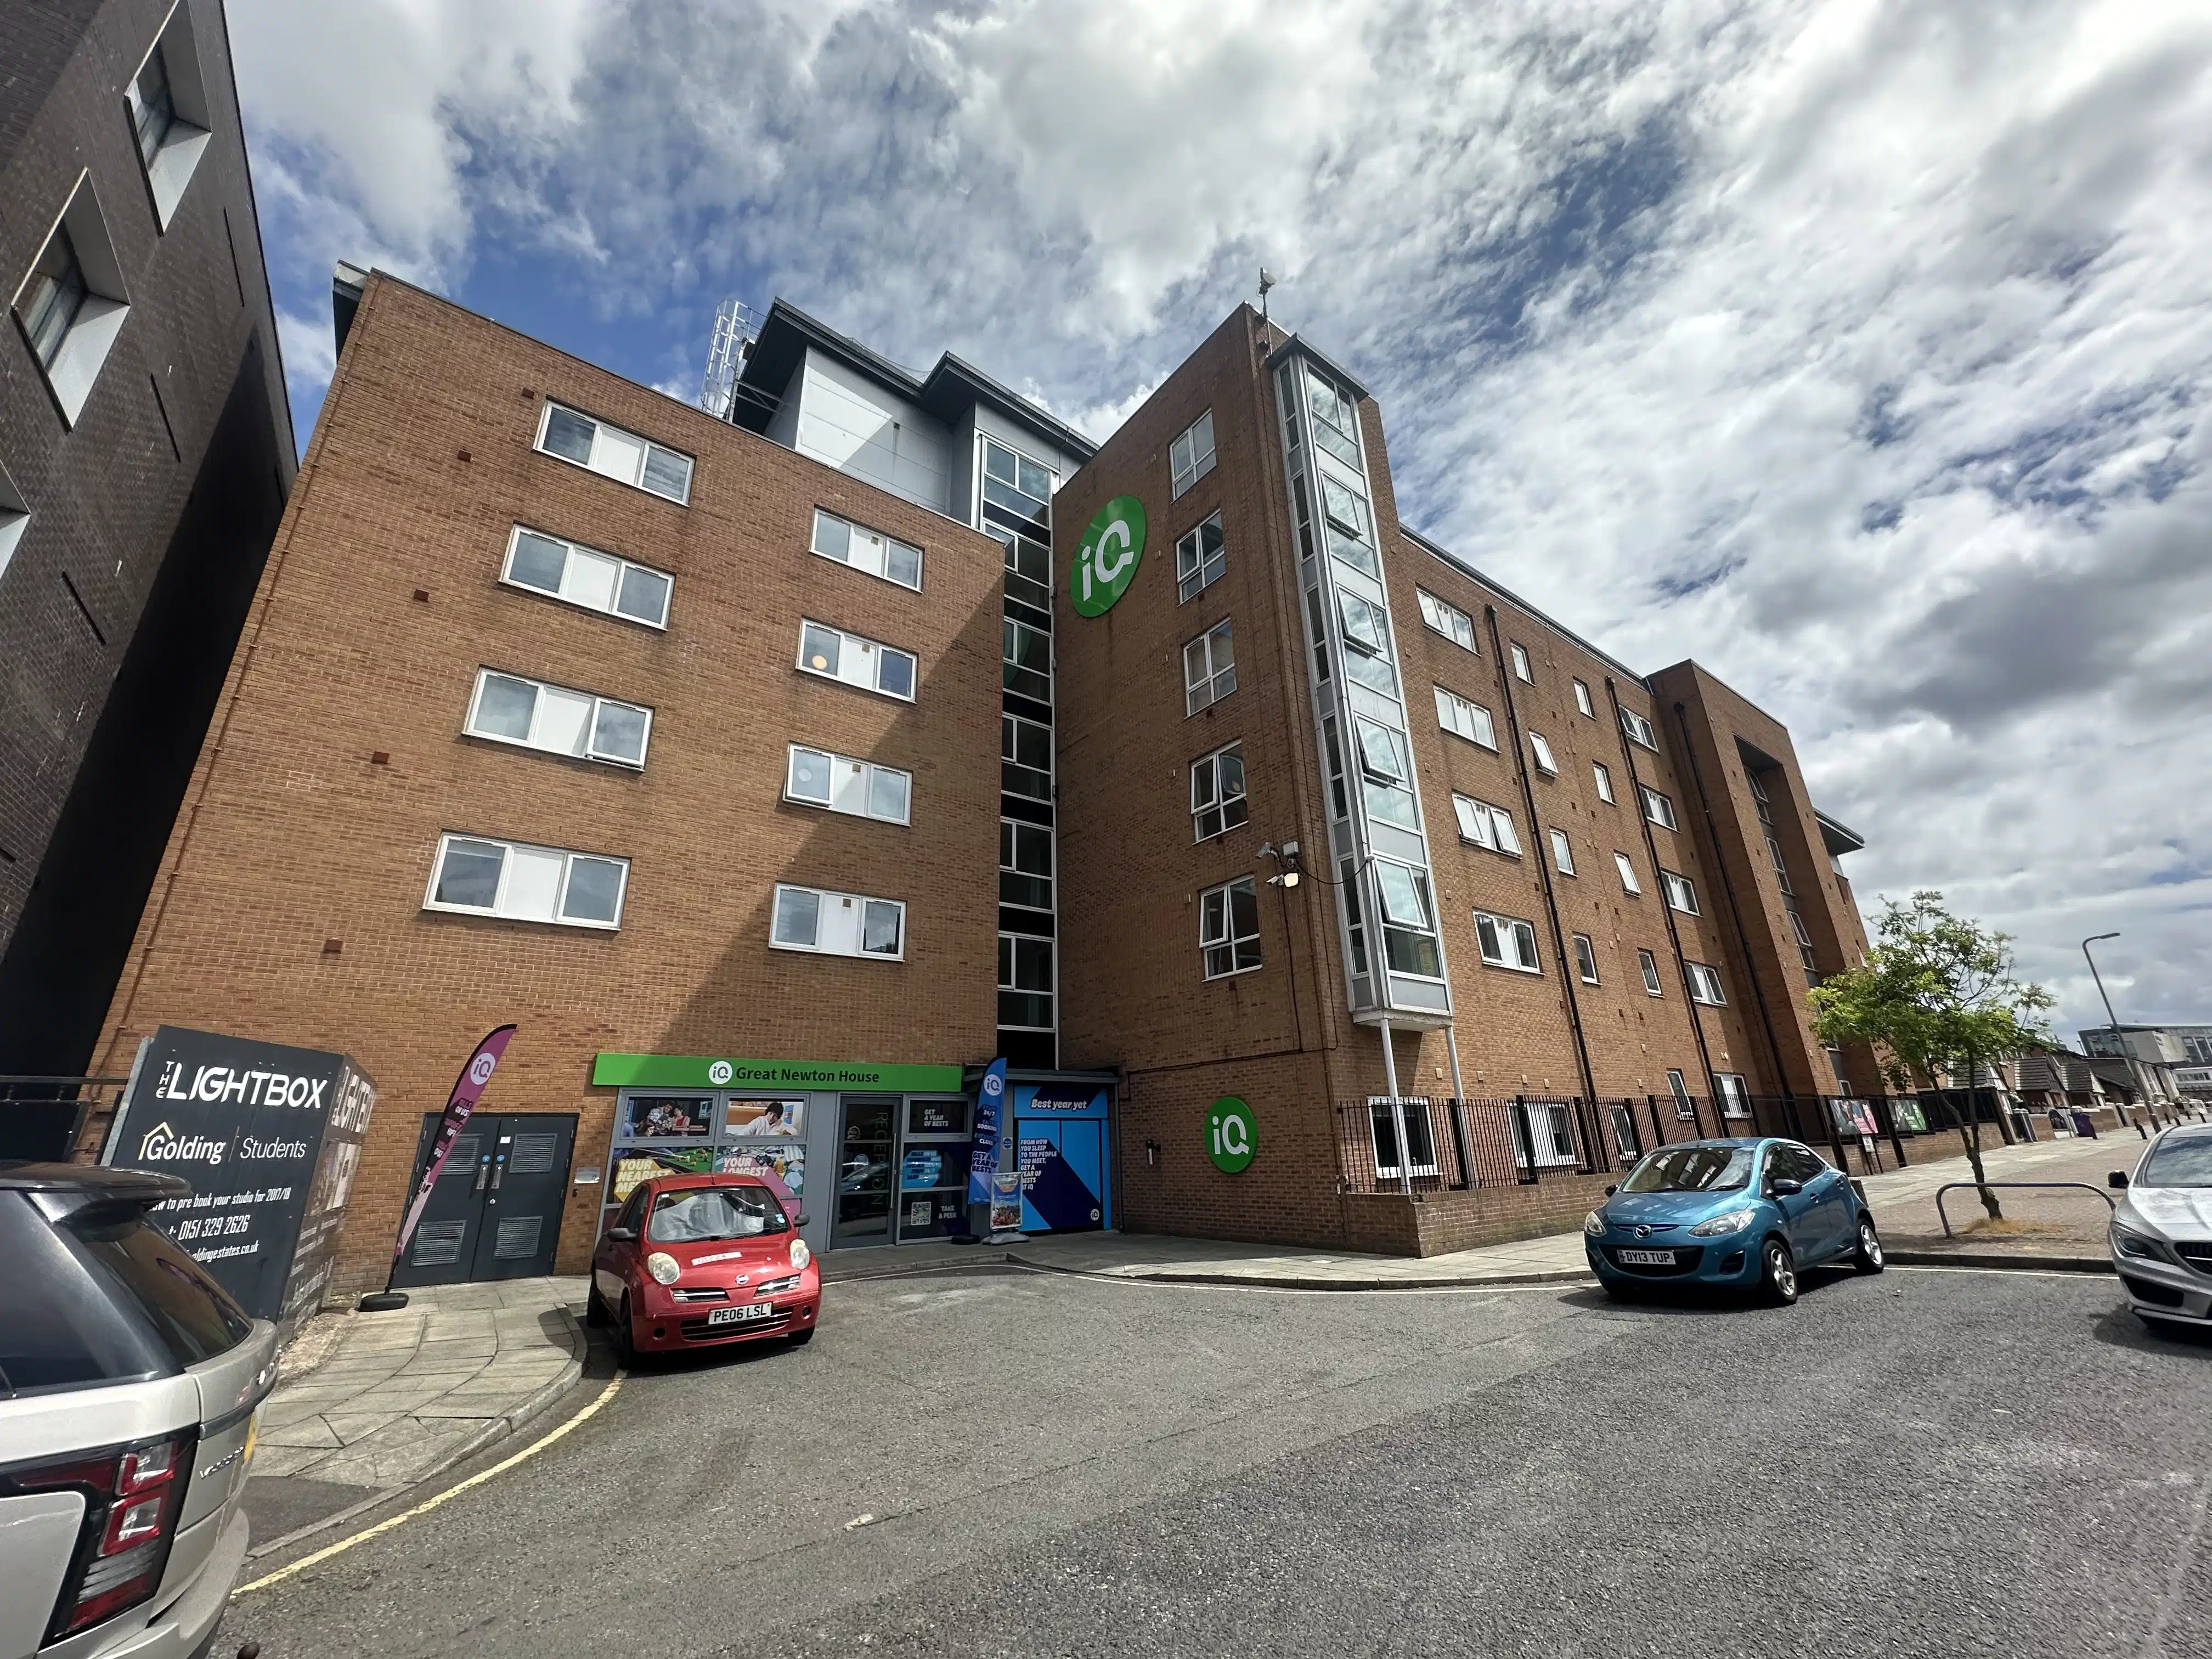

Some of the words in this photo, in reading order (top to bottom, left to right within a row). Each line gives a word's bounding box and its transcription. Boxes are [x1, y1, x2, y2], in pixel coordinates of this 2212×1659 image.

[473, 1058, 491, 1078] iQ
[712, 1065, 729, 1079] iQ
[736, 1066, 777, 1080] Great
[780, 1069, 836, 1082] Newton
[839, 1070, 879, 1083] House
[166, 1062, 328, 1109] LIGHTBOX
[987, 1078, 1000, 1091] iQ
[1031, 1099, 1052, 1108] Best
[1052, 1101, 1073, 1111] year
[1073, 1101, 1087, 1111] yet
[1211, 1114, 1250, 1155] iQ
[147, 1135, 227, 1165] Golding
[240, 1137, 307, 1160] Students
[871, 1112, 888, 1205] RECEPION
[619, 1159, 653, 1171] YOUR
[724, 1157, 753, 1167] YOUR
[972, 1165, 992, 1173] BESTS
[167, 1198, 177, 1210] to
[176, 1198, 192, 1212] pre
[193, 1193, 212, 1207] book
[212, 1196, 231, 1208] your
[231, 1190, 255, 1205] studio
[255, 1189, 266, 1203] for
[266, 1187, 292, 1202] 2017/18
[178, 1219, 202, 1240] 0151
[201, 1217, 224, 1238] 329
[223, 1215, 251, 1235] 2626
[1626, 1251, 1648, 1262] DY13
[1649, 1252, 1669, 1263] TUP
[714, 1309, 744, 1322] PE06
[746, 1305, 767, 1318] LSL
